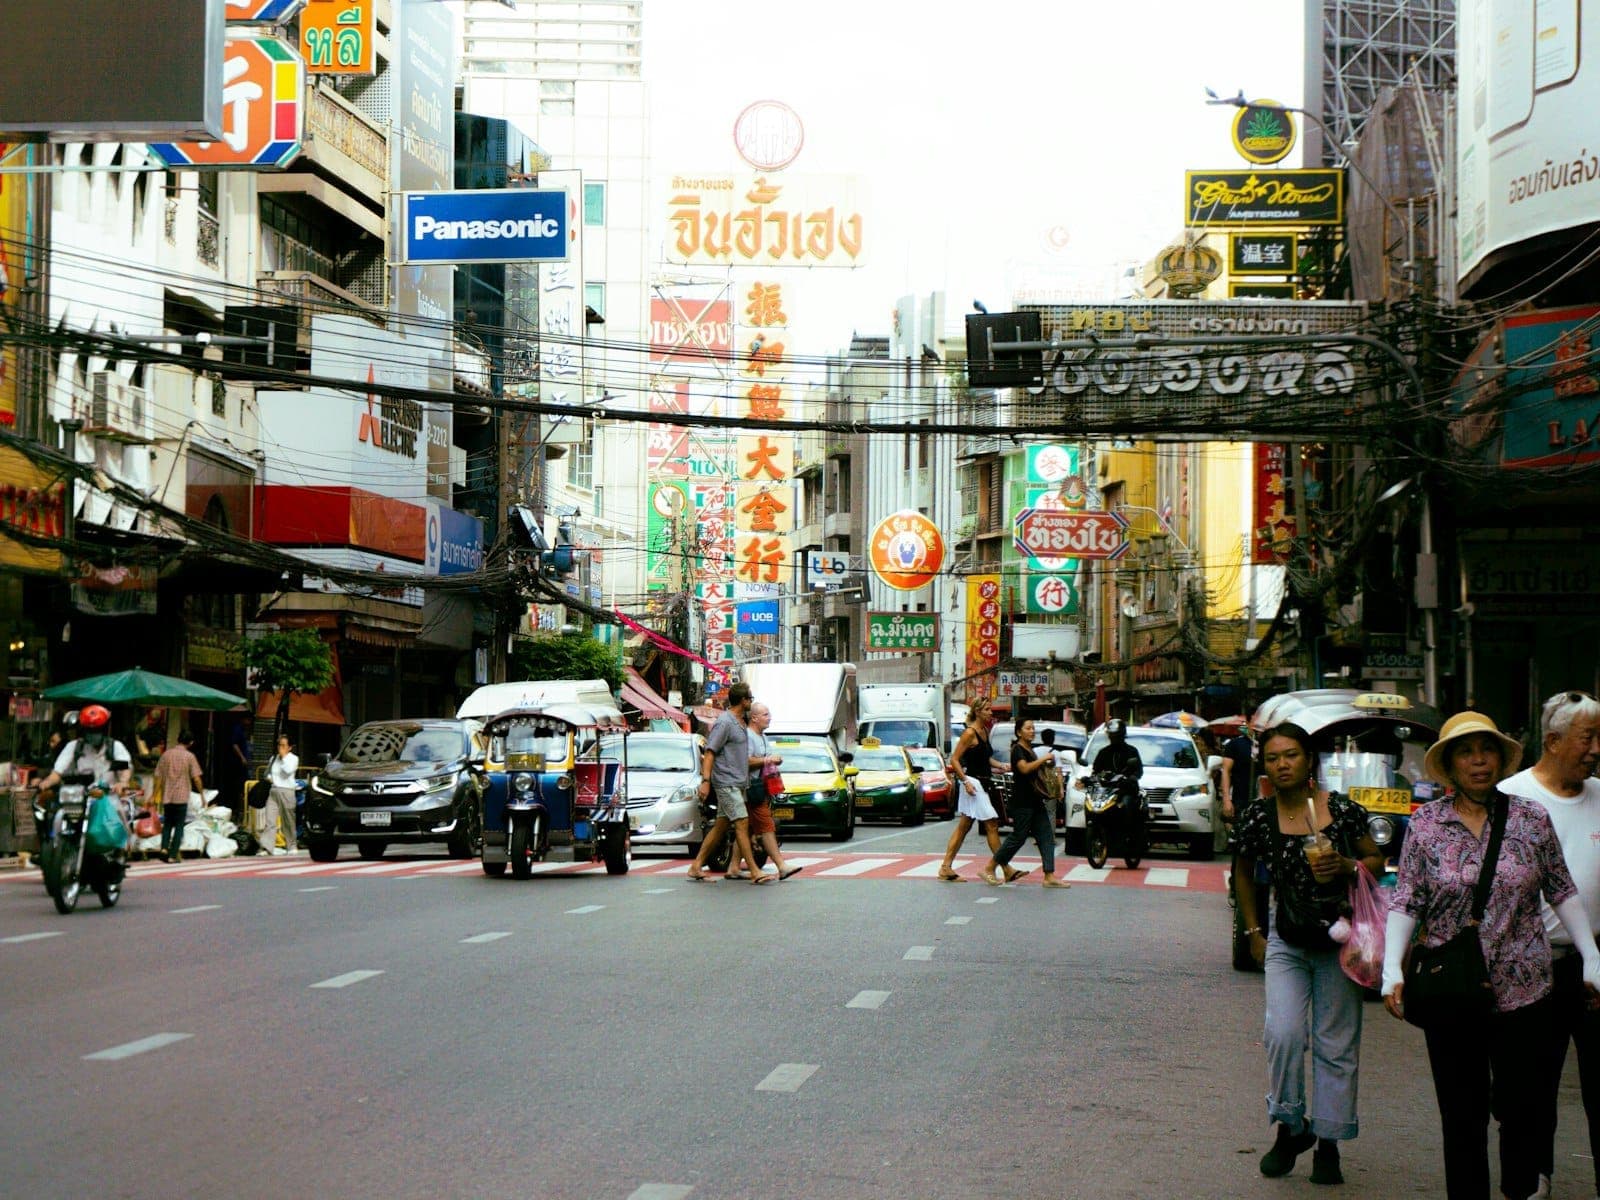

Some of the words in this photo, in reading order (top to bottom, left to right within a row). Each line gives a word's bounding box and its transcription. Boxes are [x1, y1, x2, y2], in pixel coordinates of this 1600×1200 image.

[305, 6, 362, 67] หลี
[1508, 148, 1600, 205] ออมกับเล่ง
[1194, 180, 1256, 208] Green
[1264, 181, 1334, 205] House
[1229, 210, 1300, 218] AMSTERDAM
[414, 213, 559, 240] Panasonic
[1242, 243, 1285, 264] 温室
[1072, 310, 1152, 331] ทอง
[382, 417, 420, 458] ELECTRIC
[1548, 412, 1600, 447] LA
[1032, 515, 1078, 528] ห้างทอง
[1027, 519, 1118, 552] ทองใบ
[813, 557, 845, 575] ttb
[745, 583, 770, 593] NOW
[751, 612, 774, 622] UOB
[981, 583, 998, 657] 沙县小吃
[1367, 695, 1401, 705] TAXI
